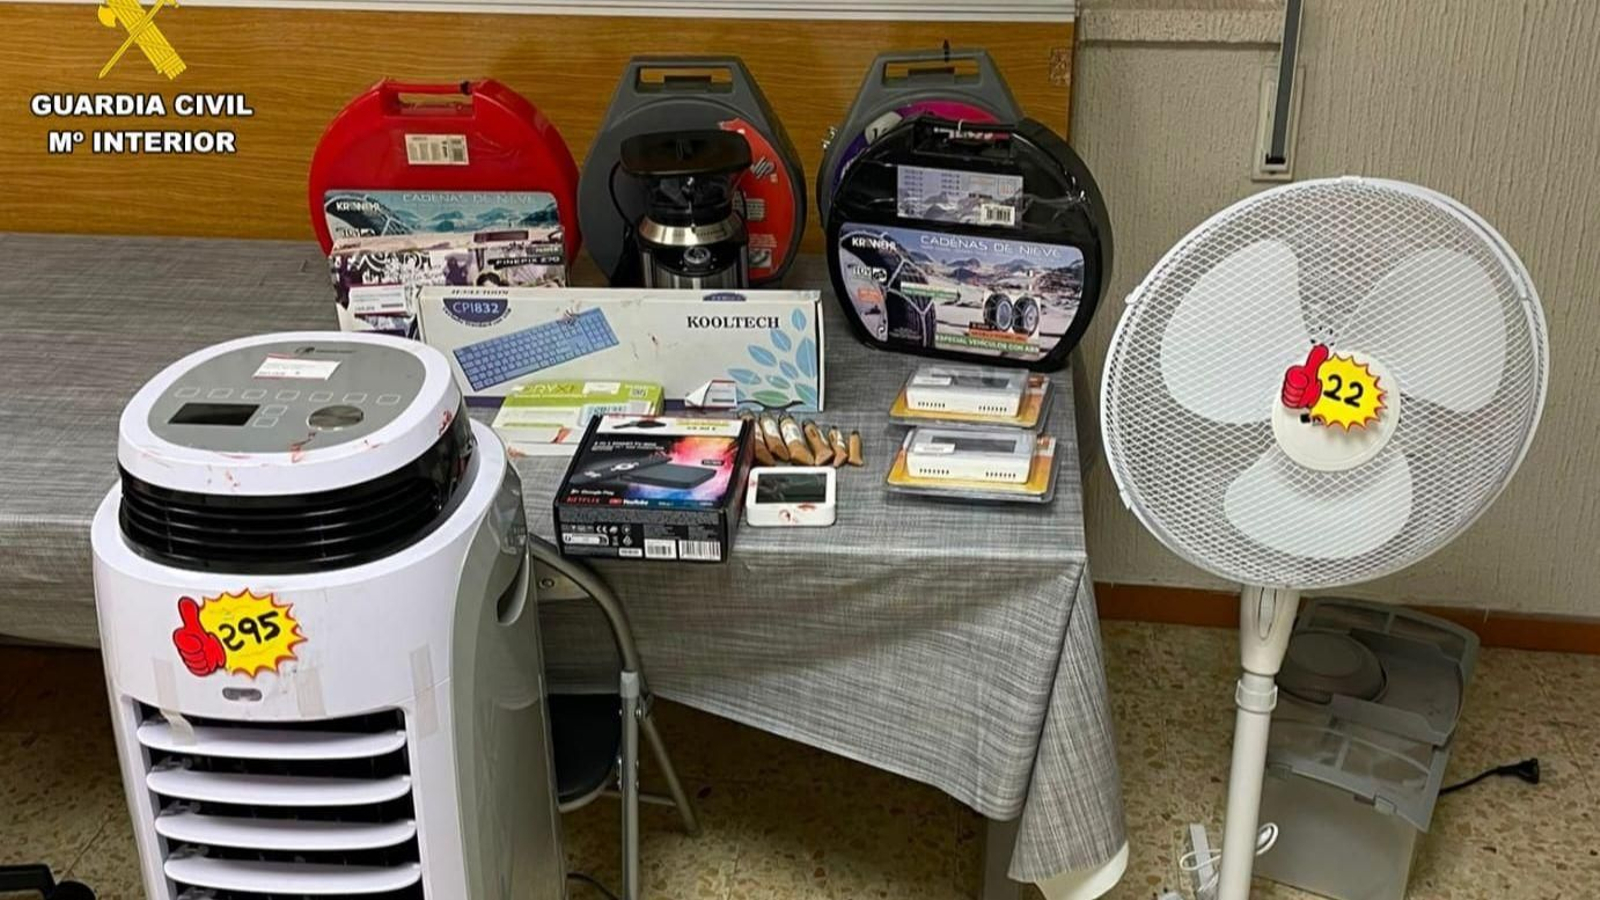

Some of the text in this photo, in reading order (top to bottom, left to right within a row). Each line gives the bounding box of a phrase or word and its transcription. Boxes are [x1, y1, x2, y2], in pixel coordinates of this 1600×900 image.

[920, 234, 989, 252] CADENAS
[993, 243, 1013, 254] DE
[1019, 244, 1063, 260] NIEVE
[686, 315, 780, 330] KOOLTECH
[1322, 373, 1364, 408] 22
[218, 610, 281, 652] 295
